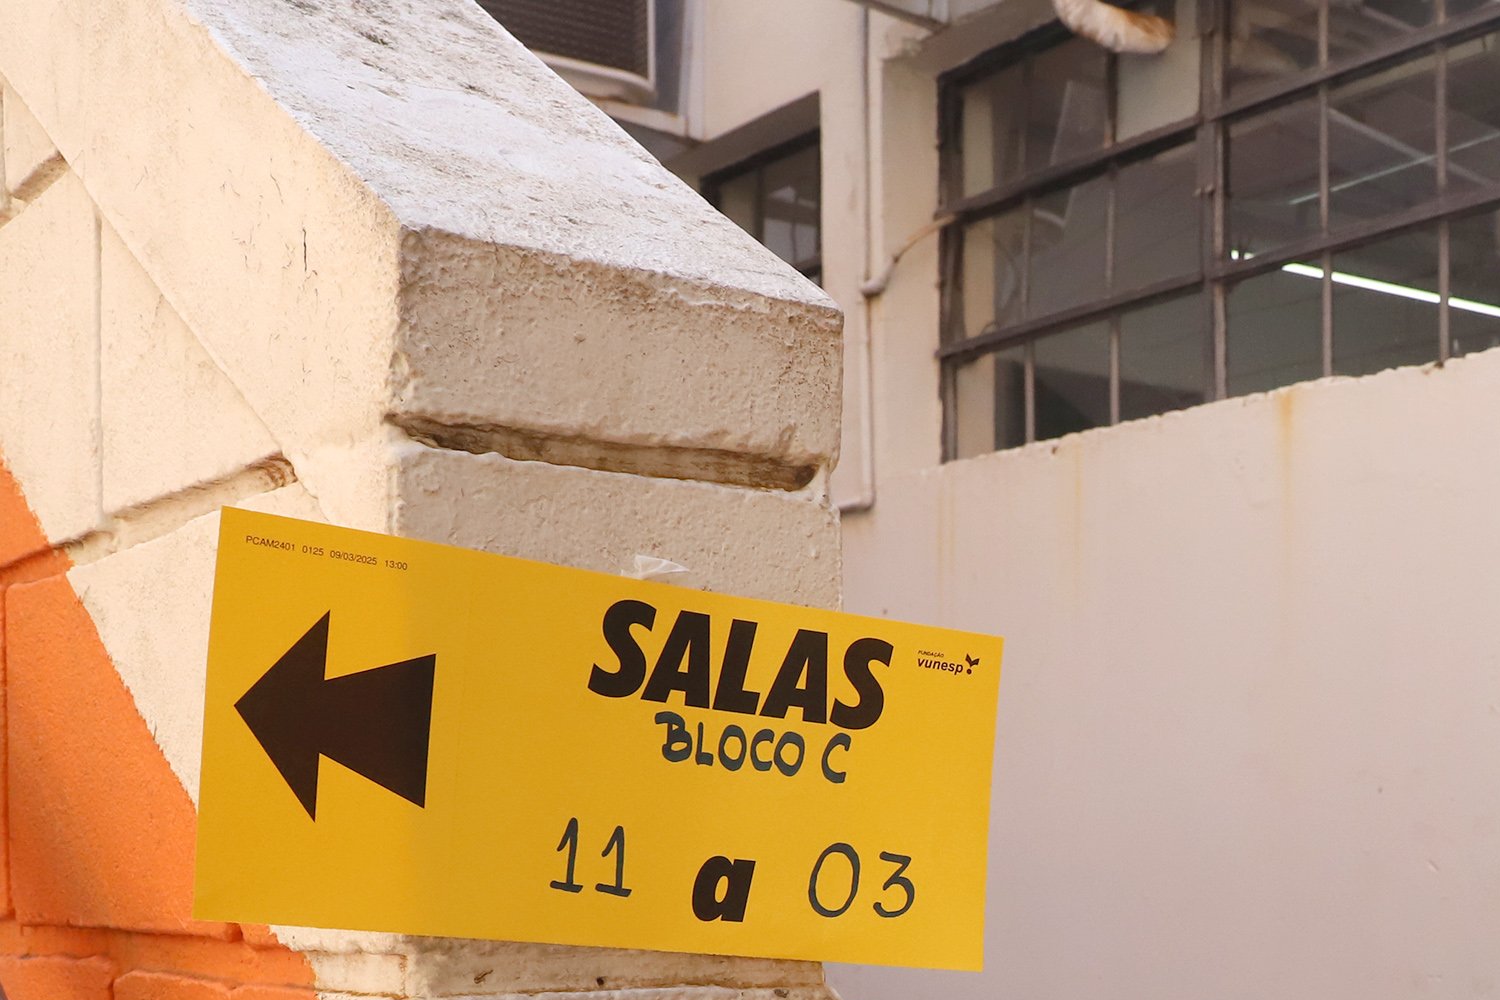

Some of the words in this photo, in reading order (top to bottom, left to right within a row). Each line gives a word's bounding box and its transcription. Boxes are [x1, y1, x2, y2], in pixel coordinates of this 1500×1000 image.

[245, 535, 295, 551] PCAM2401
[301, 545, 324, 556] 0125
[329, 550, 378, 566] 09/03/2025
[384, 559, 408, 571] 13:00
[587, 599, 894, 730] SALAS
[917, 658, 963, 675] vunesp
[654, 710, 805, 777] BLOCO
[821, 732, 851, 784] C
[549, 817, 632, 897] 11
[691, 855, 756, 923] a
[808, 842, 915, 918] 03
